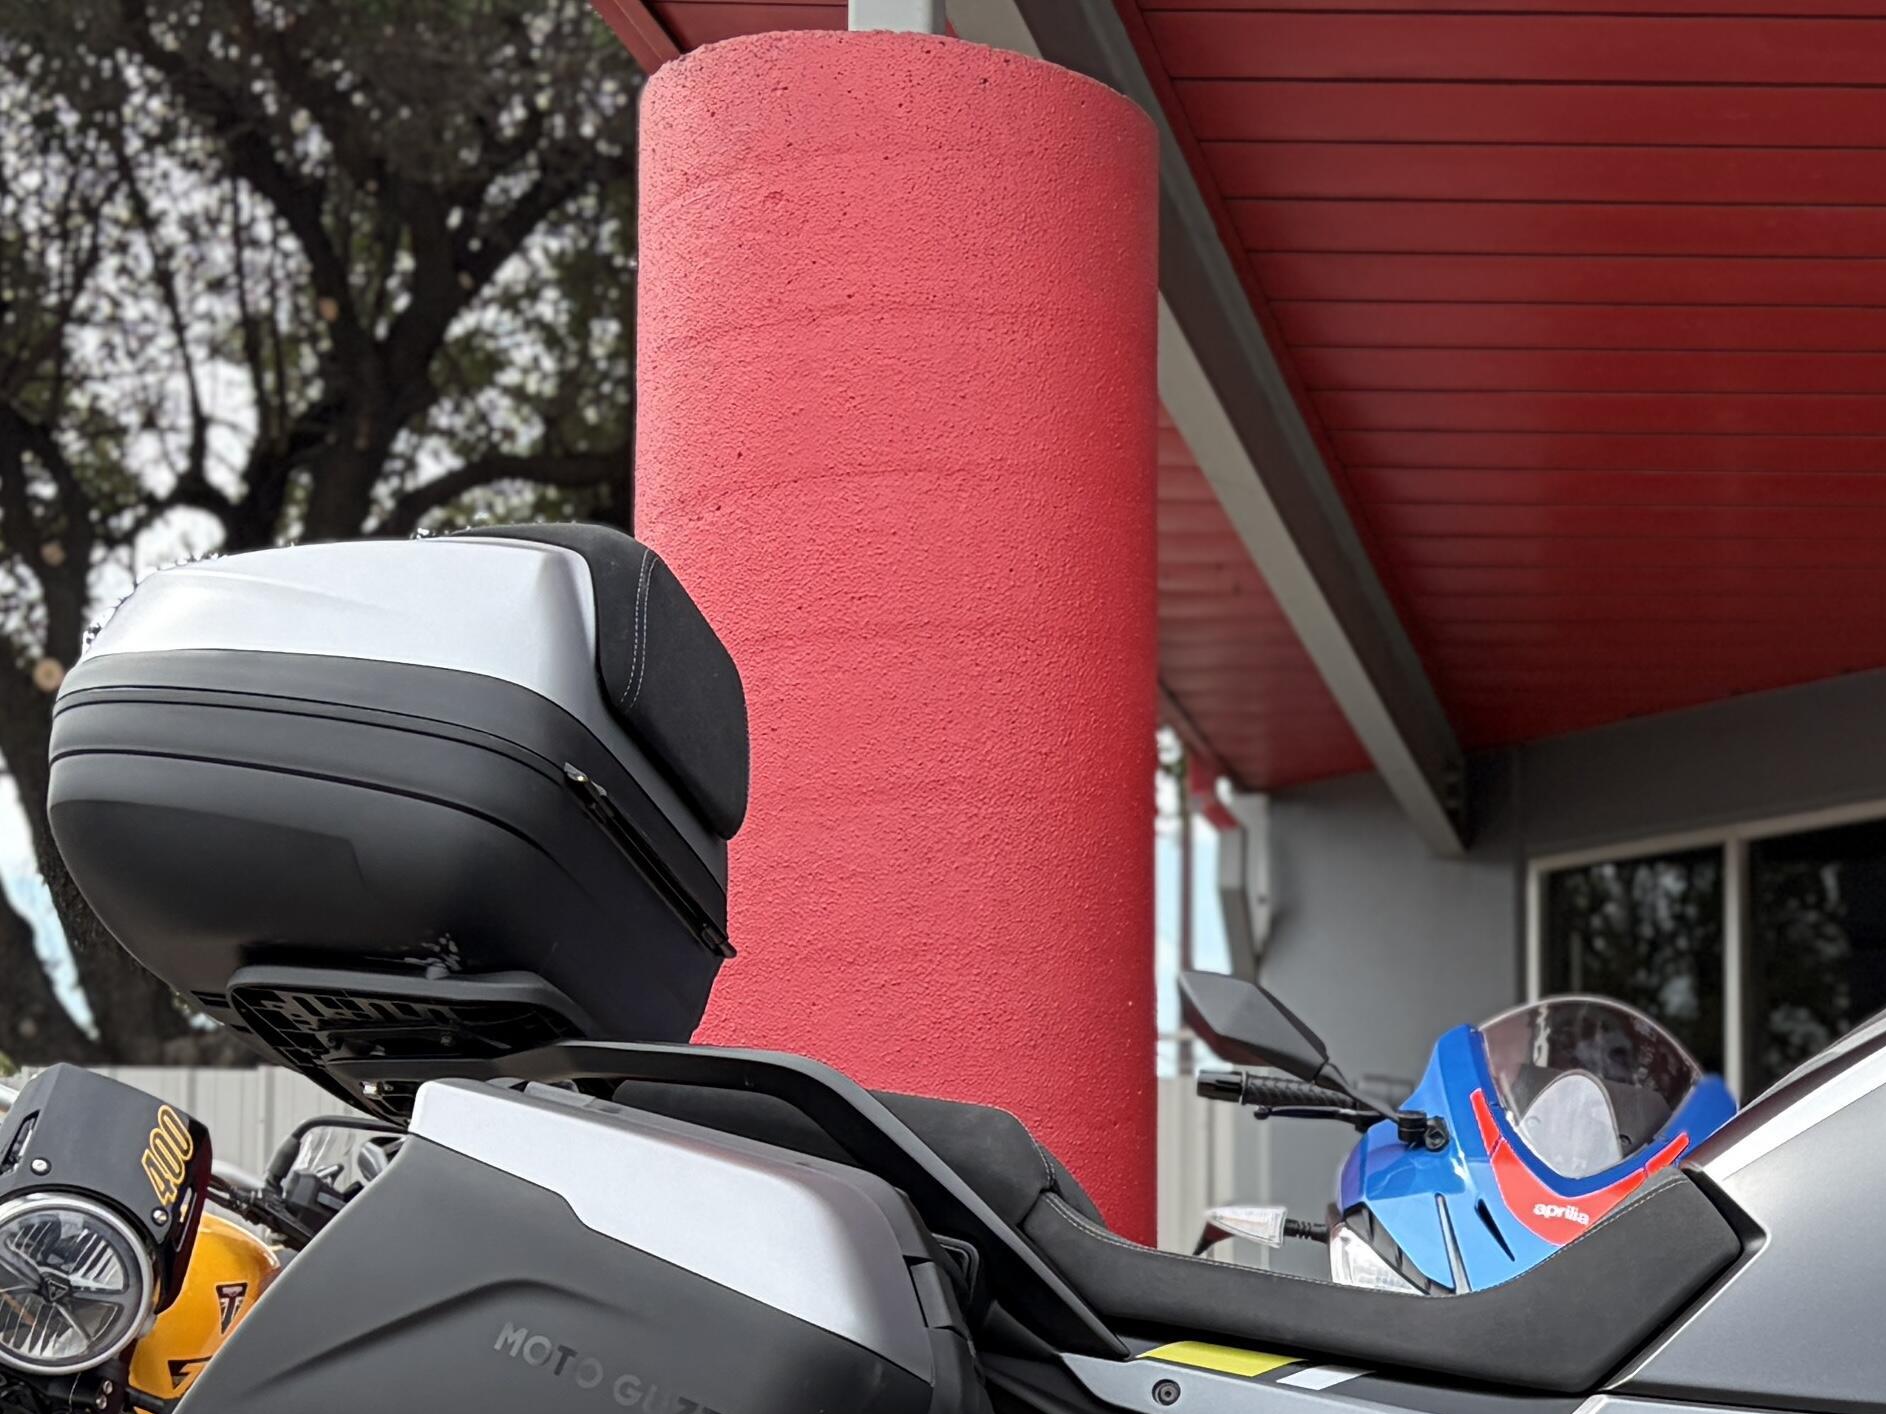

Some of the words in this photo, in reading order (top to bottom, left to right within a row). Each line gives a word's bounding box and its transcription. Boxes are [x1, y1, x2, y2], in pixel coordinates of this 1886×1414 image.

[142, 1104, 193, 1207] 400
[1532, 1201, 1590, 1226] aprilia
[494, 1321, 604, 1390] MOTO
